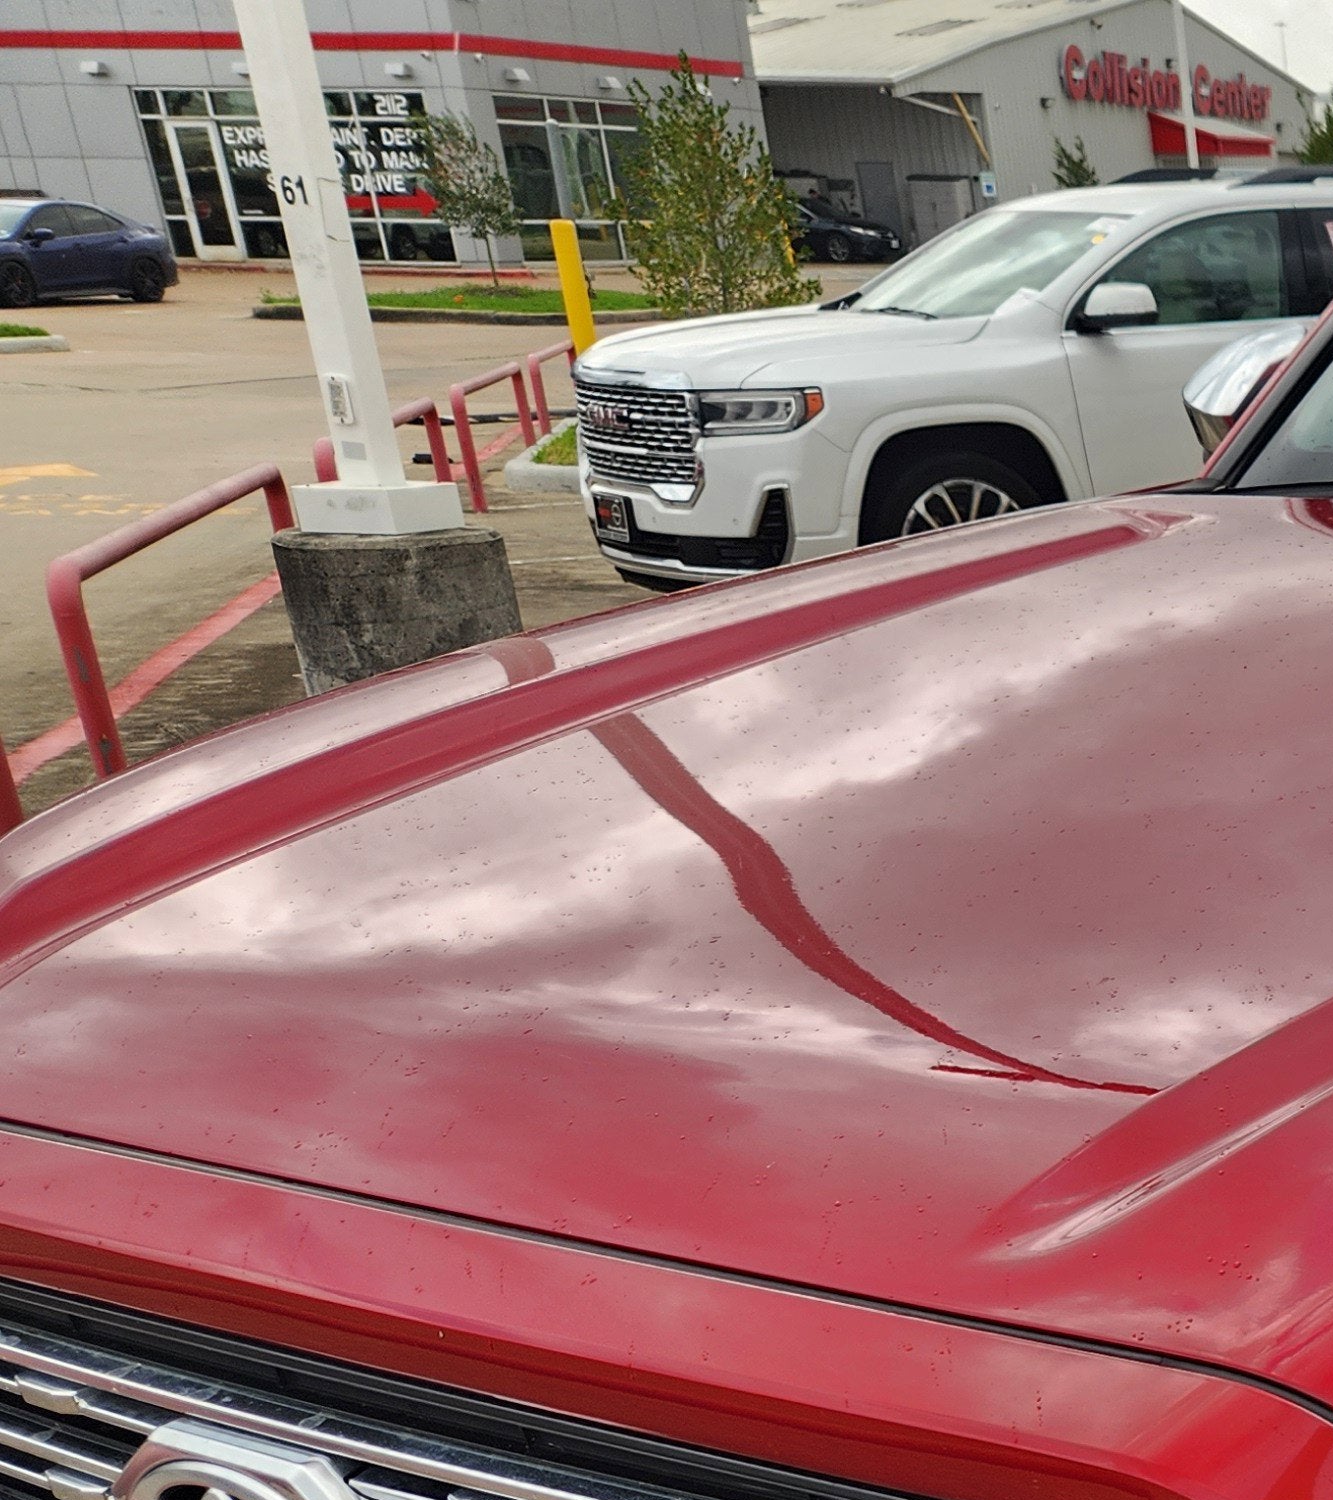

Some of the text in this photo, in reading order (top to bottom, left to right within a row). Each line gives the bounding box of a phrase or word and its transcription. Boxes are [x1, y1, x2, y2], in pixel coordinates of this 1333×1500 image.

[1063, 44, 1272, 120] Collision Center
[373, 93, 409, 116] 2112
[234, 149, 270, 168] HAS
[349, 150, 376, 169] TO
[280, 174, 310, 205] 61
[587, 402, 630, 430] GMC
